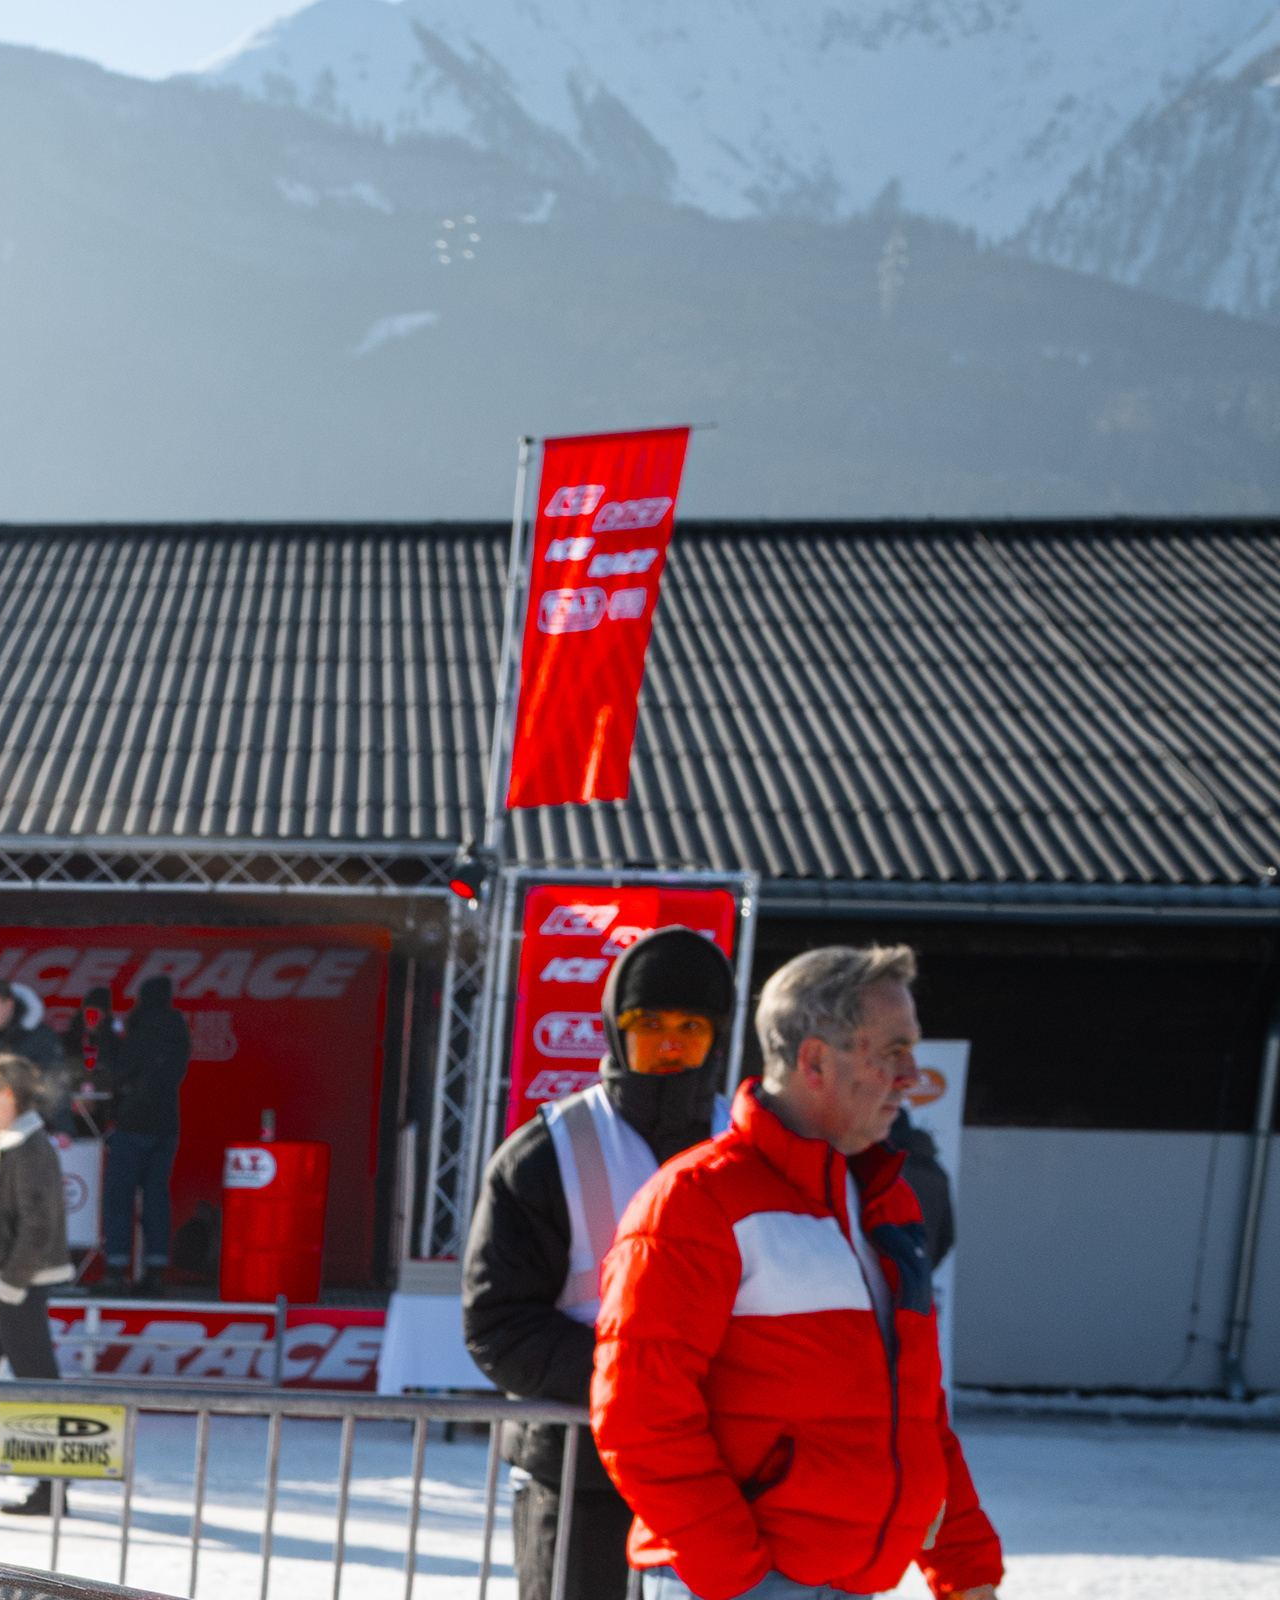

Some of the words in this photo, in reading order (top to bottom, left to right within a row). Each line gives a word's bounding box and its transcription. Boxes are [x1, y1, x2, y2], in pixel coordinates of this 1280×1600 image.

[122, 947, 370, 999] RACE
[114, 1320, 384, 1381] RACE
[2, 1438, 55, 1462] JOHNNY
[60, 1440, 111, 1466] SERVIS
